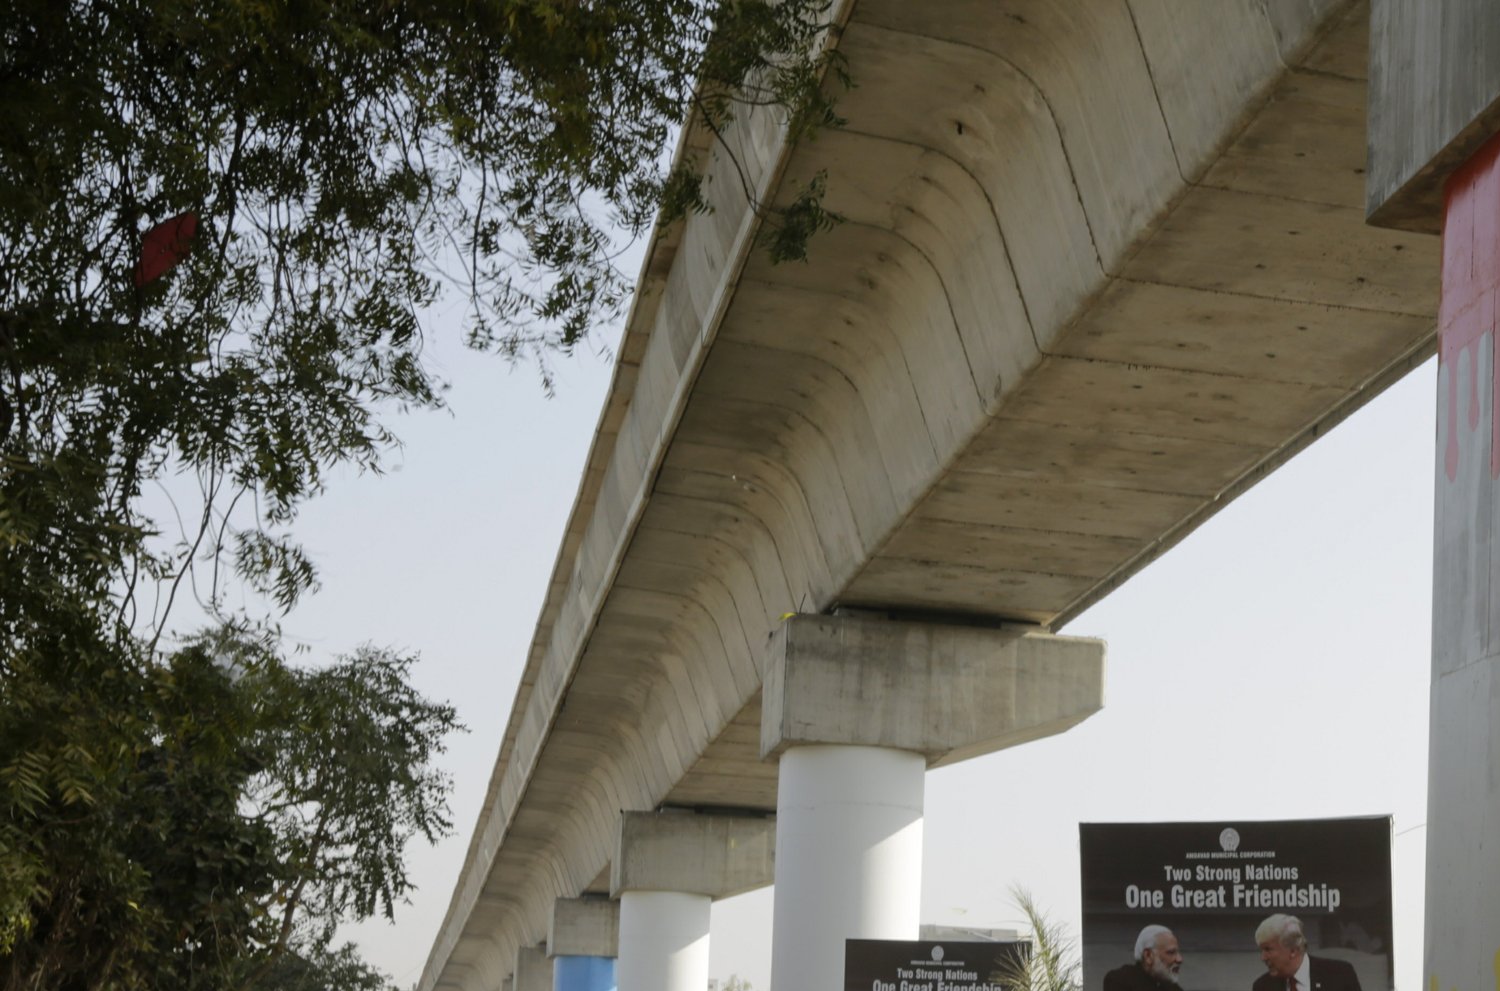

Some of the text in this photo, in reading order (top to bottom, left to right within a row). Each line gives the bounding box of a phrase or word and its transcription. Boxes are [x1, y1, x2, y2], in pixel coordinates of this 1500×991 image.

[1164, 864, 1299, 884] Two Strong Nations
[1125, 883, 1341, 912] One Great Friendship
[897, 967, 978, 983] Two Strong Nations
